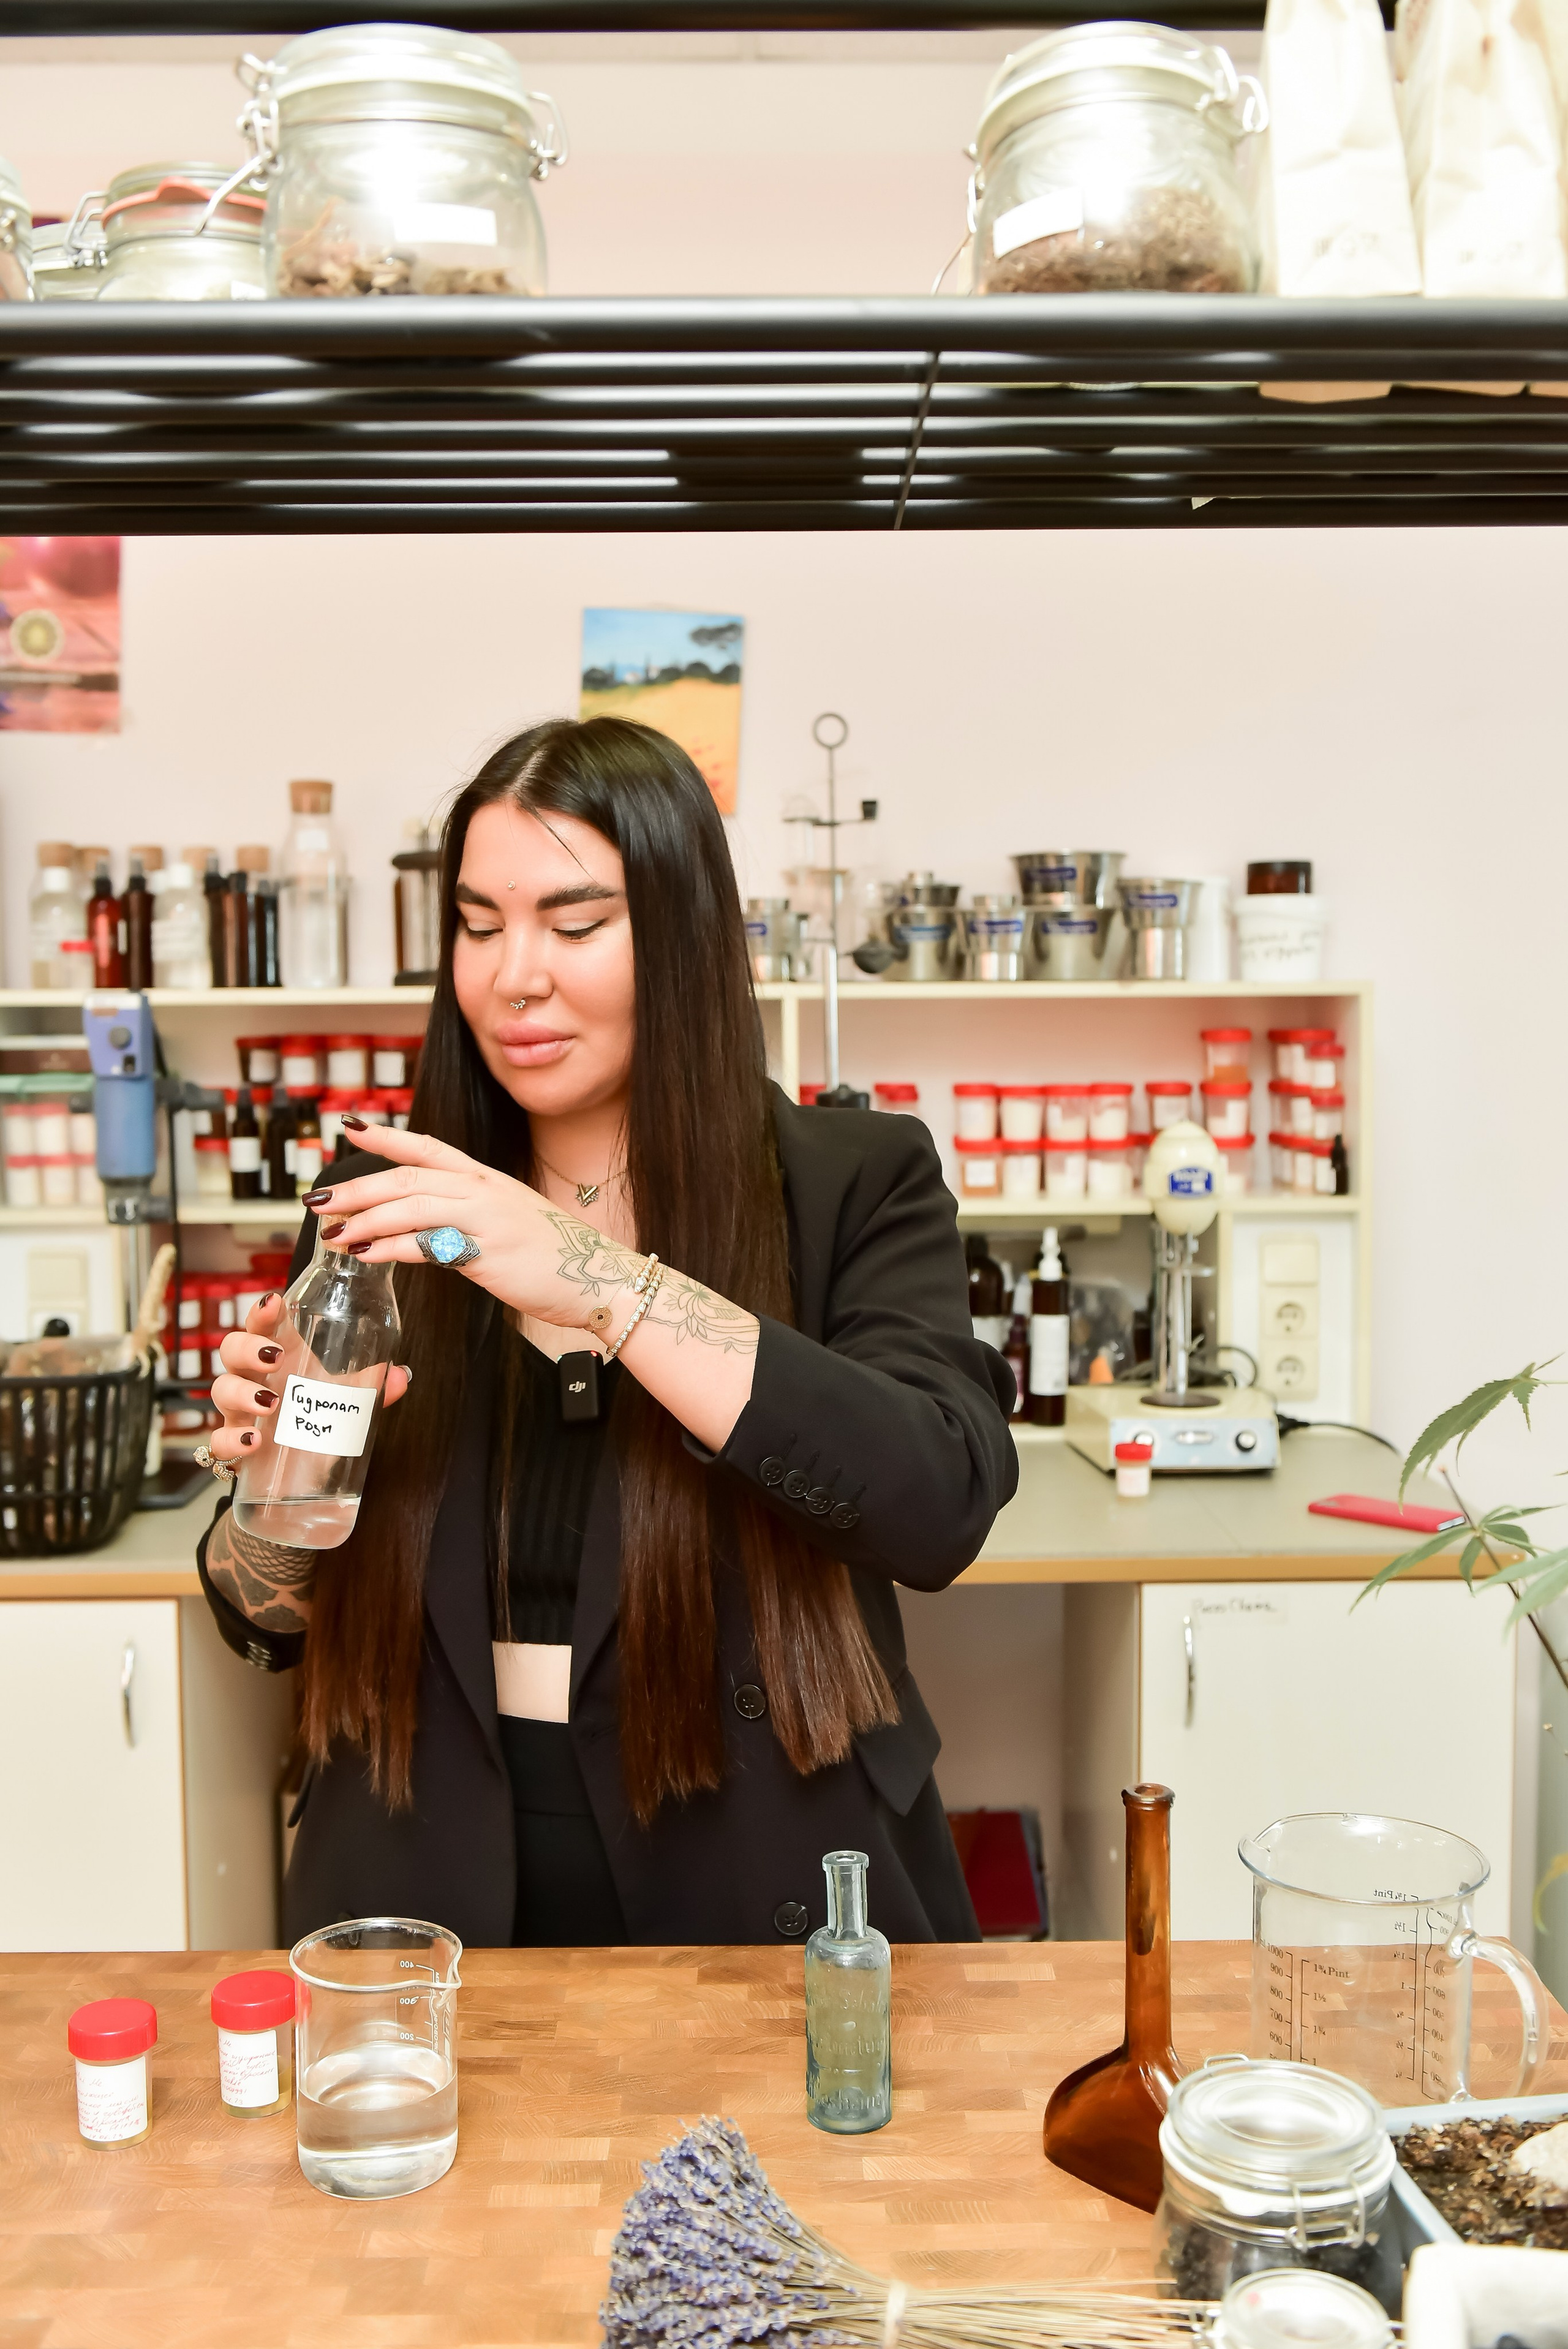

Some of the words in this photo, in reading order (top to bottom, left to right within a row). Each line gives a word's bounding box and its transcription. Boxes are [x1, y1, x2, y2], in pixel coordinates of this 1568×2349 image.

[1270, 1963, 1284, 1977] 900
[1328, 1966, 1351, 1979] Pint
[1270, 1985, 1283, 2000] 800
[1270, 2007, 1283, 2023] 700
[1269, 2030, 1283, 2045] 600
